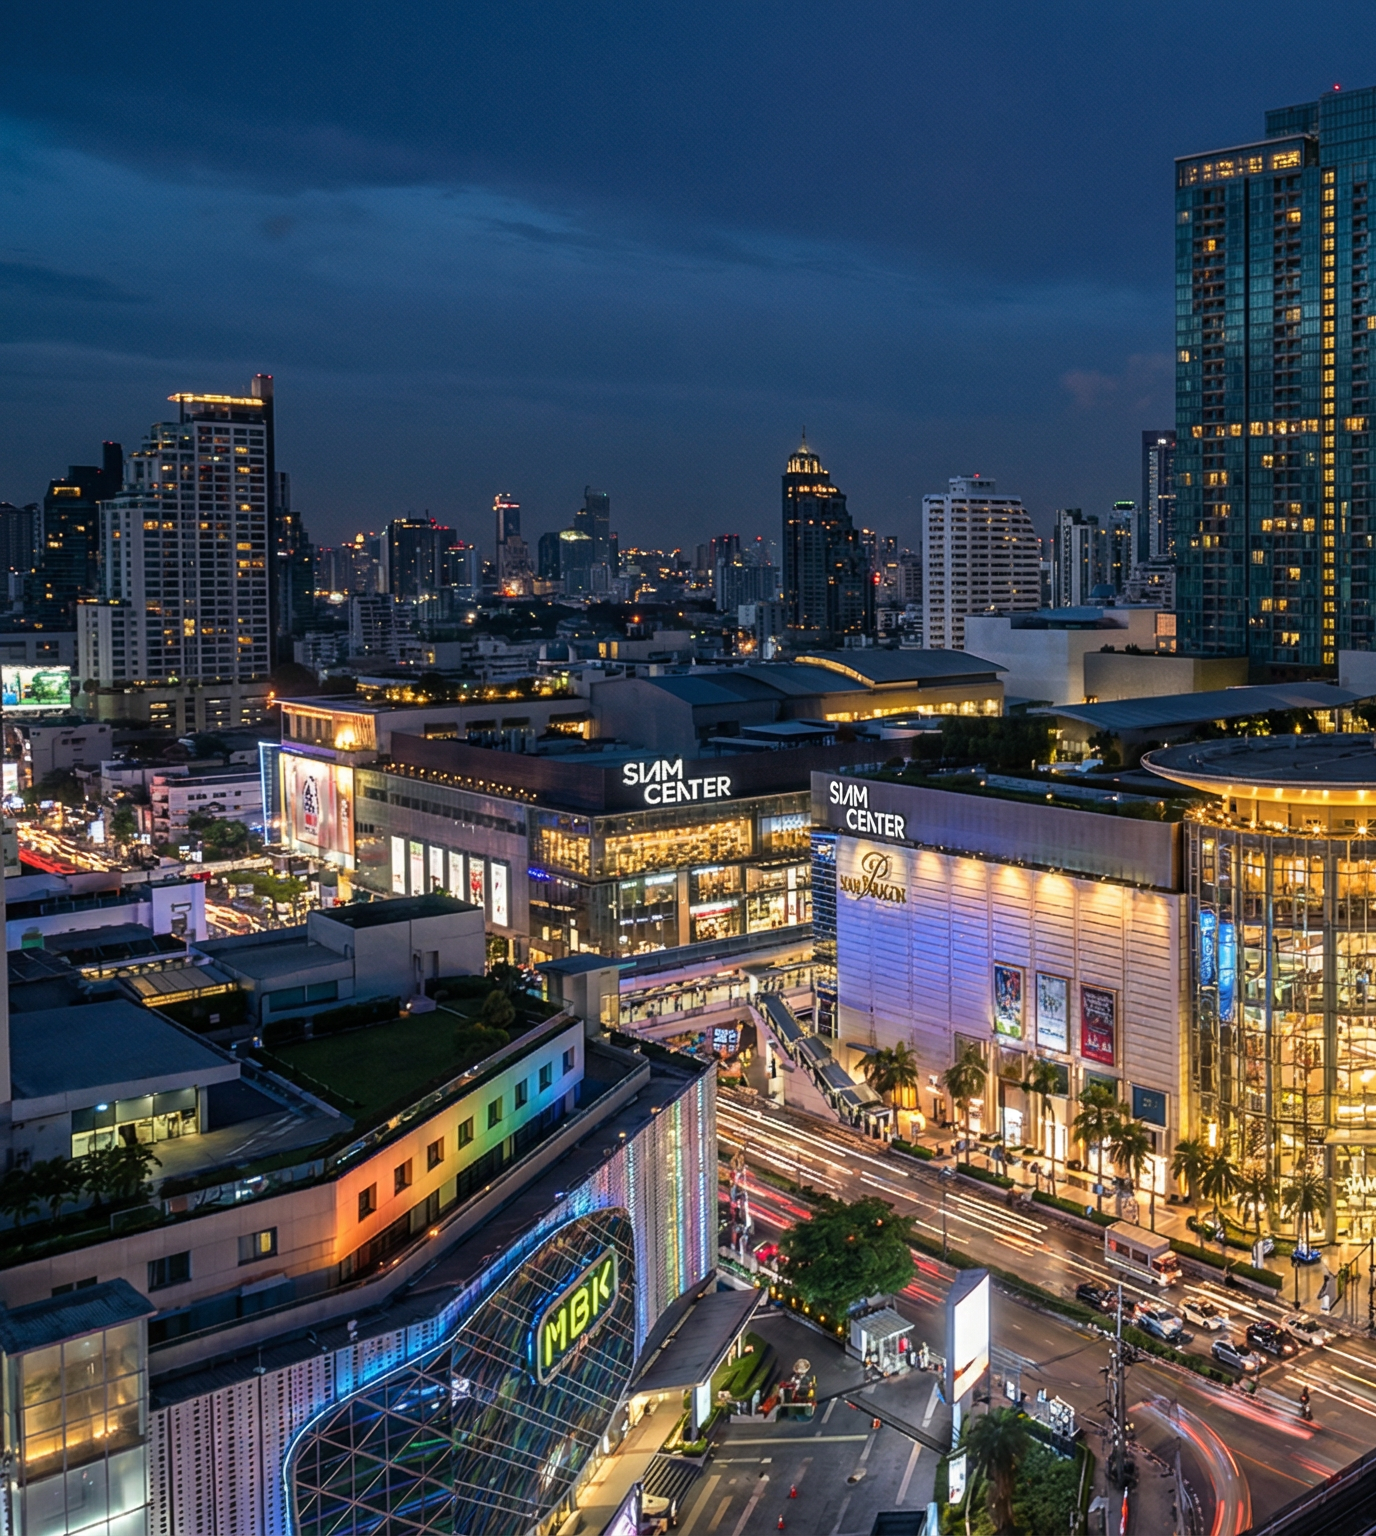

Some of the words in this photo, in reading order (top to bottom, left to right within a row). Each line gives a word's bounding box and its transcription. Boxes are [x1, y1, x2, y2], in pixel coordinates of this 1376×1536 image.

[622, 758, 683, 785] SIAM
[644, 776, 731, 804] CENTER
[829, 780, 868, 808] SIAM
[846, 808, 905, 839] CENTER
[545, 1260, 612, 1367] MBK
